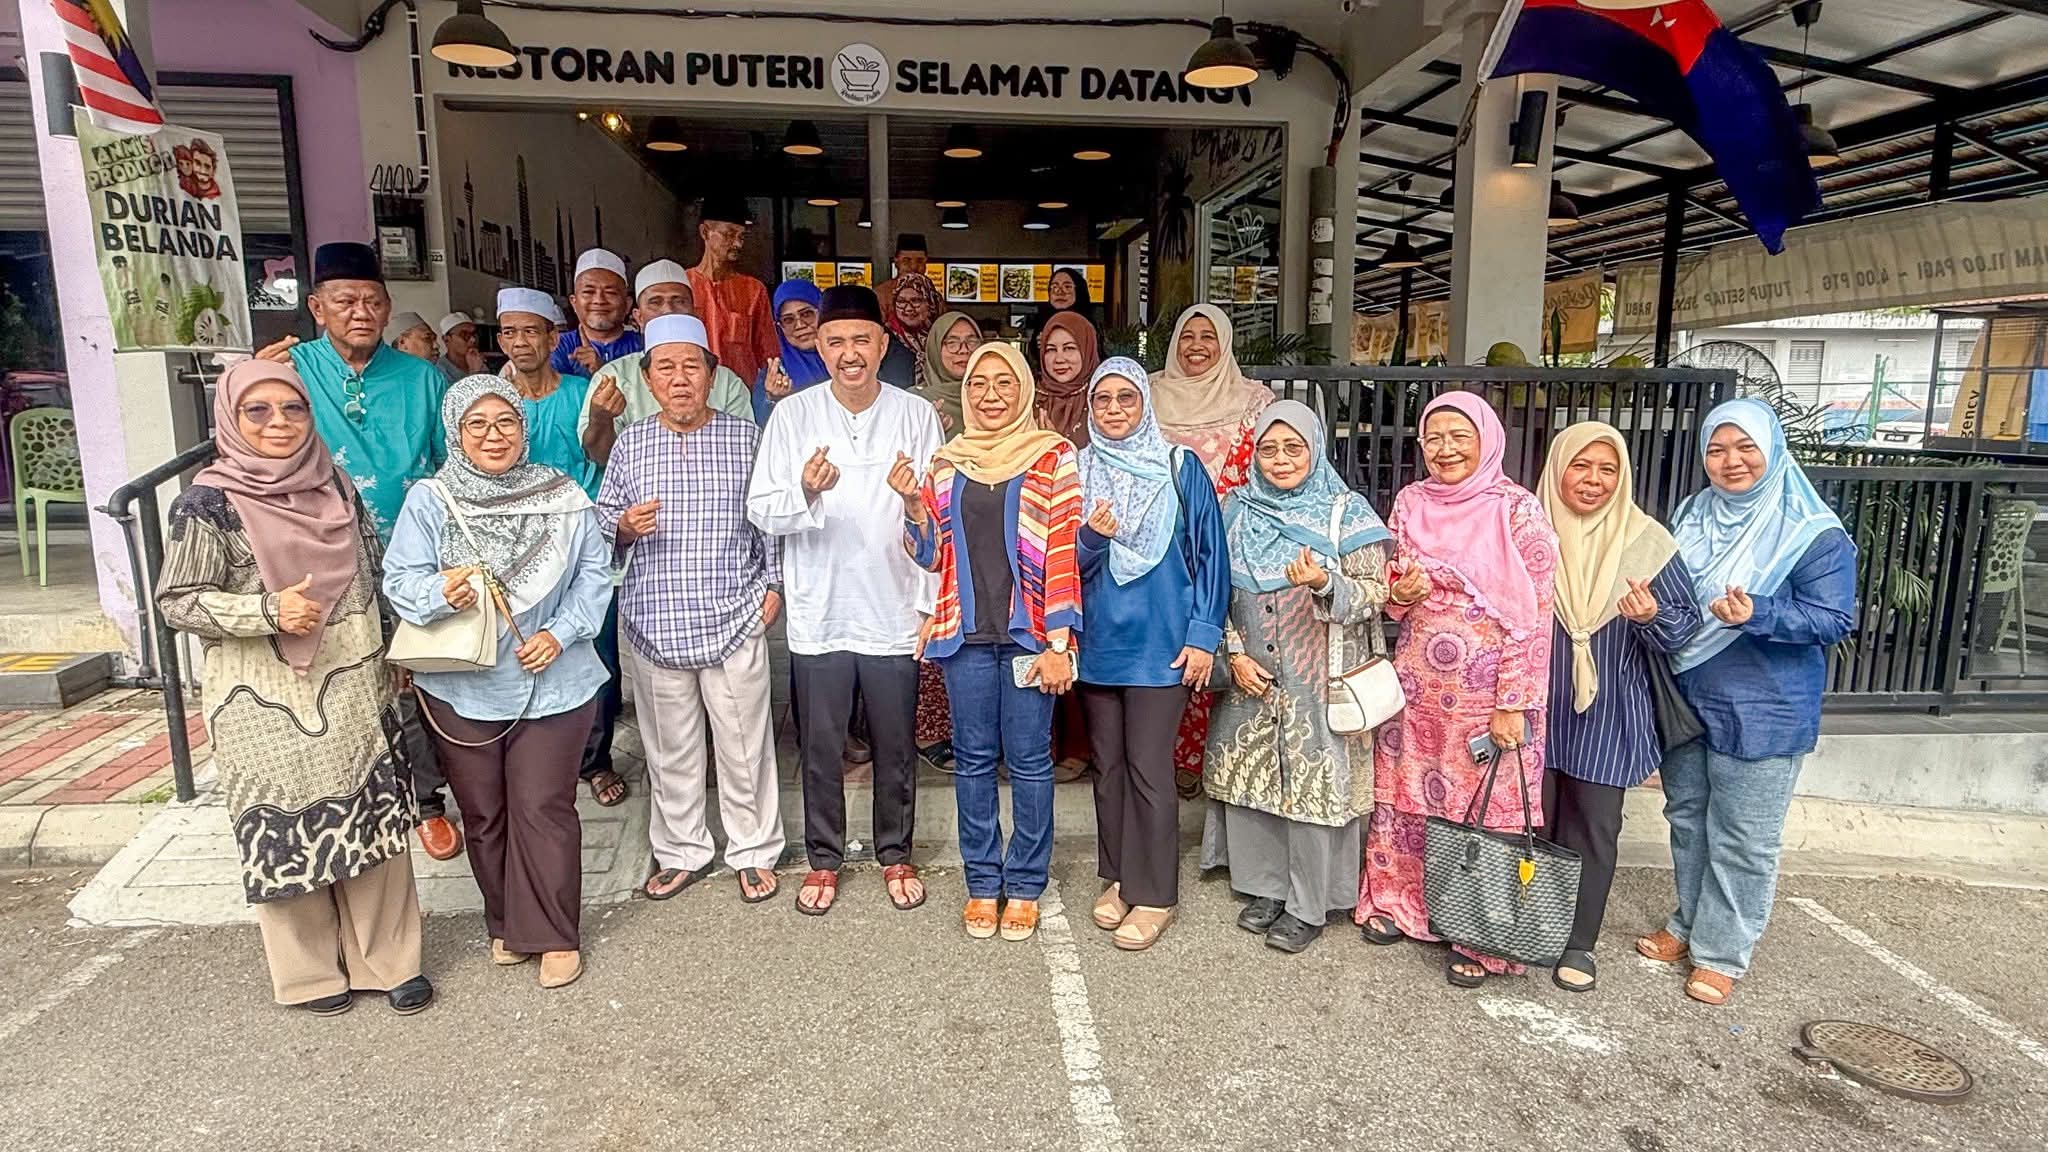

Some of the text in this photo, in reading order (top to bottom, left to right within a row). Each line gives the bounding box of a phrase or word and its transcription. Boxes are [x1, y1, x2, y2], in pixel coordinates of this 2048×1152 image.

[686, 52, 824, 90] PUTERI
[895, 59, 1070, 98] SELAMAT
[105, 190, 222, 231] DURIAN
[100, 222, 239, 262] BELANDA
